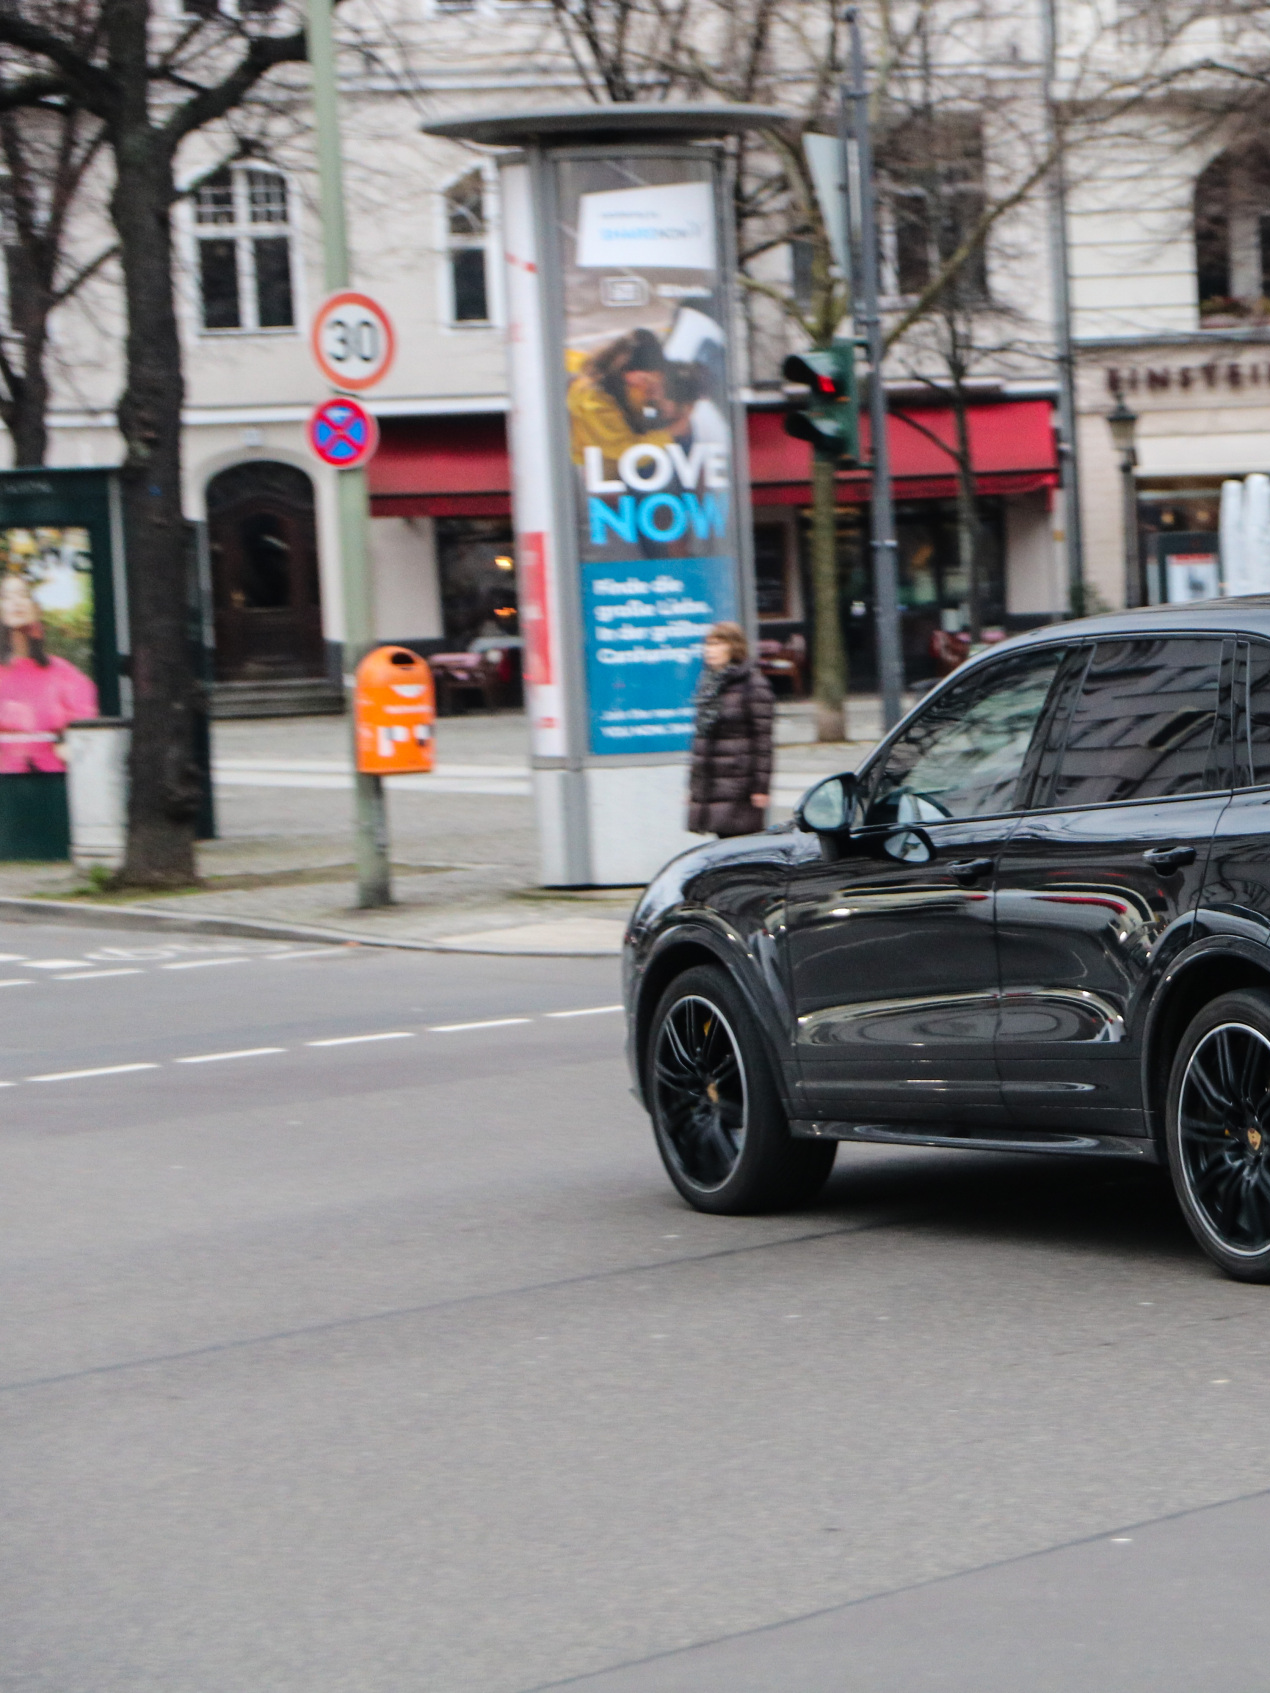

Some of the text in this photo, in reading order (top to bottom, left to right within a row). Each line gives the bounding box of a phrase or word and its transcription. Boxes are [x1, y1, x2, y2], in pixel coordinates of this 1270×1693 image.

[327, 319, 380, 362] 30
[584, 443, 729, 493] LOVE
[588, 493, 729, 545] NOW
